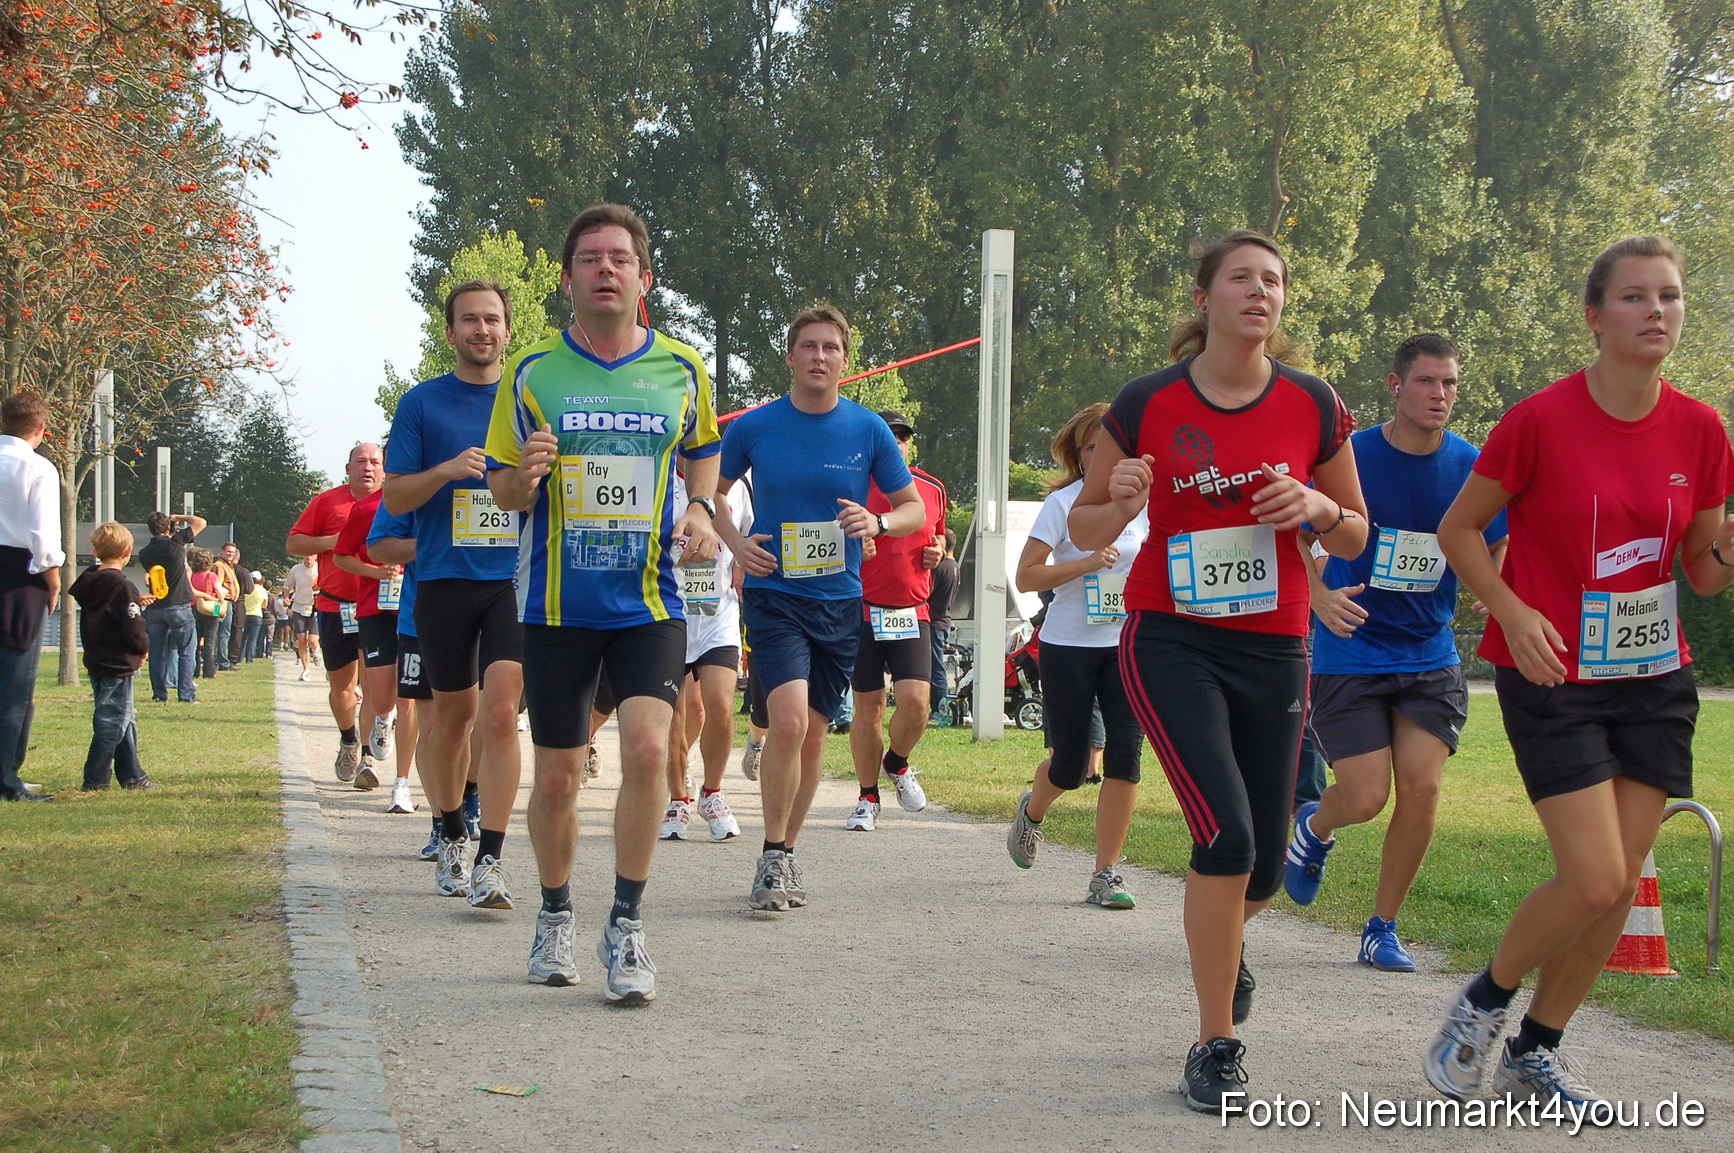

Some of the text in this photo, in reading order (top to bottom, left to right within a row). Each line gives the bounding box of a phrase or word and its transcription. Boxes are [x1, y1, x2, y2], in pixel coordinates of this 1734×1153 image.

[563, 396, 610, 405] TEAM
[560, 411, 669, 435] BOCK
[587, 462, 609, 479] Roy
[1198, 461, 1291, 496] spors
[1171, 465, 1221, 494] just
[566, 484, 573, 495] C
[596, 485, 638, 506] 691
[479, 512, 510, 528] 263
[618, 519, 652, 527] PFLEIDERER
[799, 526, 820, 540] Jörg
[1402, 533, 1429, 546] Felix
[806, 542, 837, 559] 262
[1199, 541, 1252, 560] Sandra
[1615, 547, 1641, 566] DEHN
[1203, 558, 1267, 586] 3788
[1397, 555, 1438, 573] 3797
[685, 569, 715, 577] Alexander
[685, 581, 716, 592] 2704
[1616, 598, 1659, 617] Melanie
[884, 617, 914, 628] 2083
[1588, 625, 1596, 637] D
[1615, 619, 1670, 648] 2553
[403, 653, 421, 678] 16
